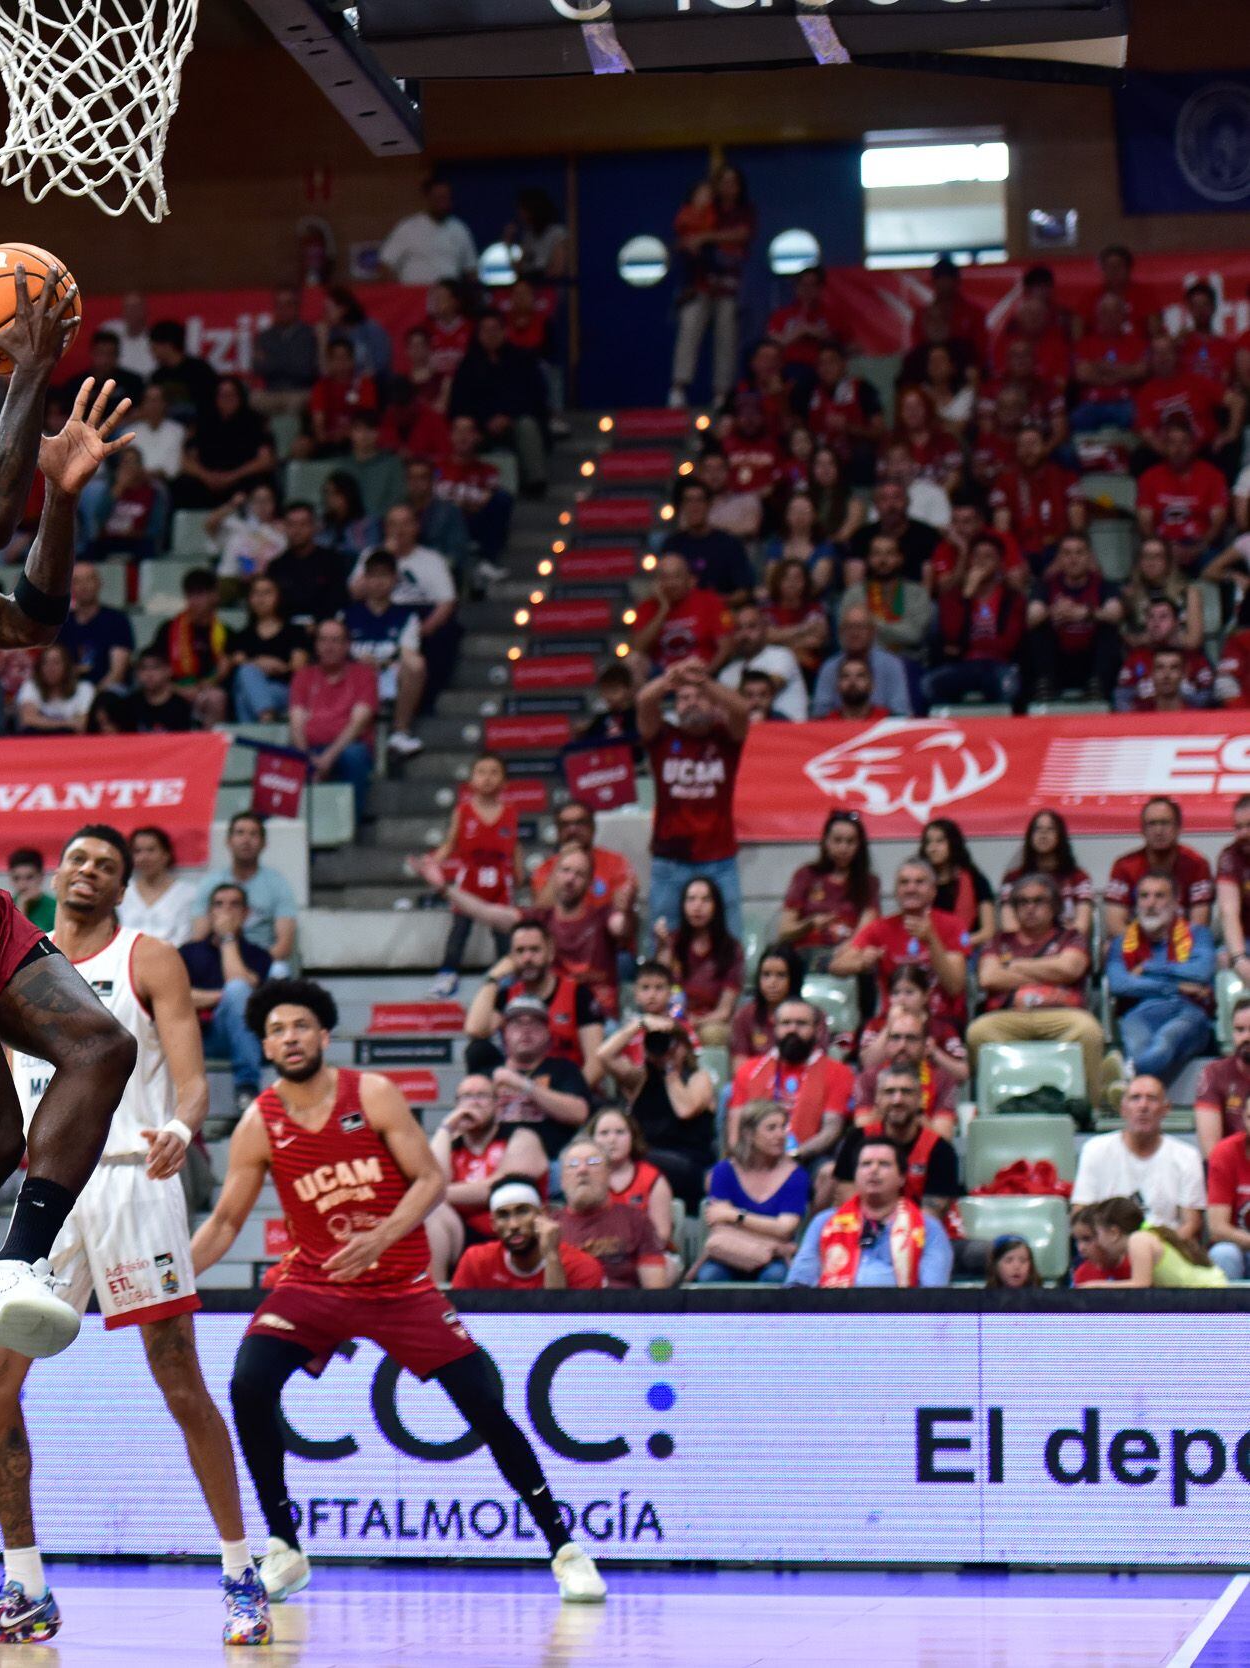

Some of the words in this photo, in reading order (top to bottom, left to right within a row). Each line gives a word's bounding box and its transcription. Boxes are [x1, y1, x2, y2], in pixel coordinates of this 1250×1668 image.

[293, 1157, 383, 1202] UCAM
[108, 1277, 135, 1295] ETL
[916, 1407, 1004, 1484] El
